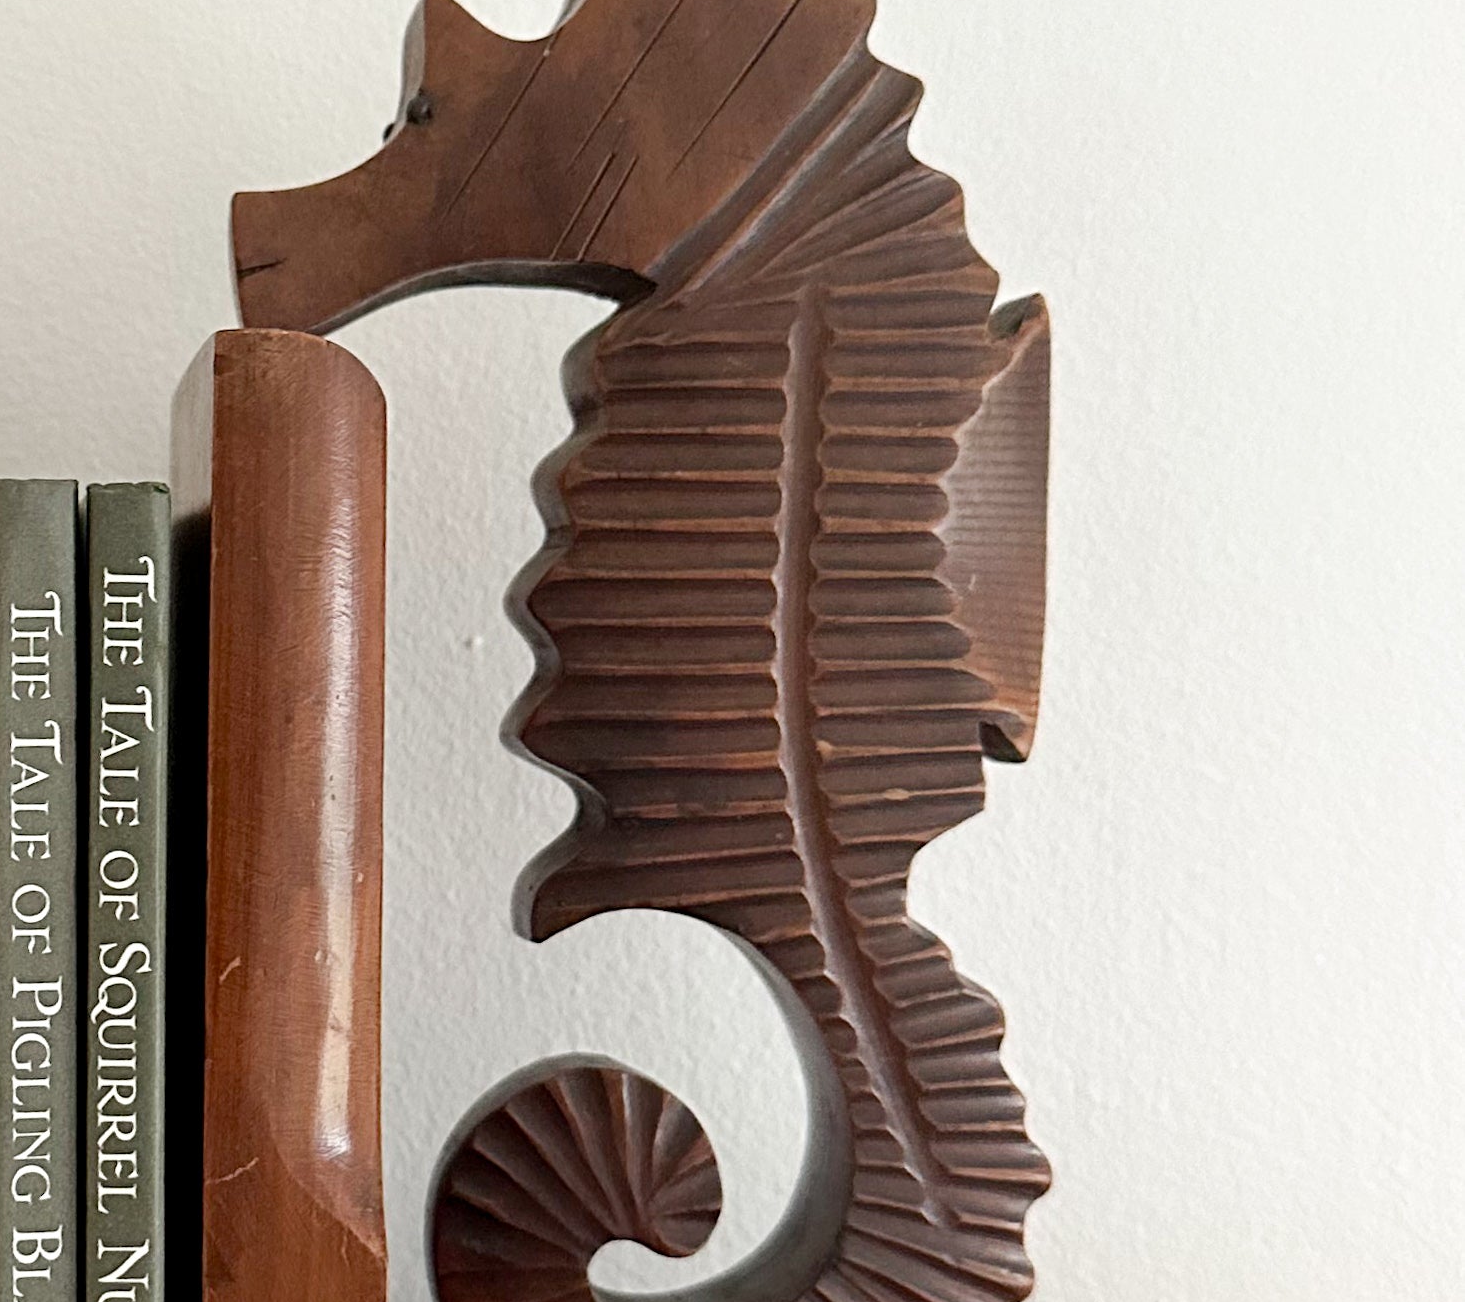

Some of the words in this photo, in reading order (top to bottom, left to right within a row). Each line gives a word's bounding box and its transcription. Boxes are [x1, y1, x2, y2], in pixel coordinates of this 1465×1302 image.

[10, 590, 63, 701] THE
[103, 555, 158, 667] THE
[10, 719, 63, 862] TALE
[99, 685, 155, 828] TALE
[11, 884, 52, 954] OF
[99, 850, 140, 921] OF
[11, 975, 63, 1204] PIGLING
[90, 942, 152, 1214] SQUIRREL
